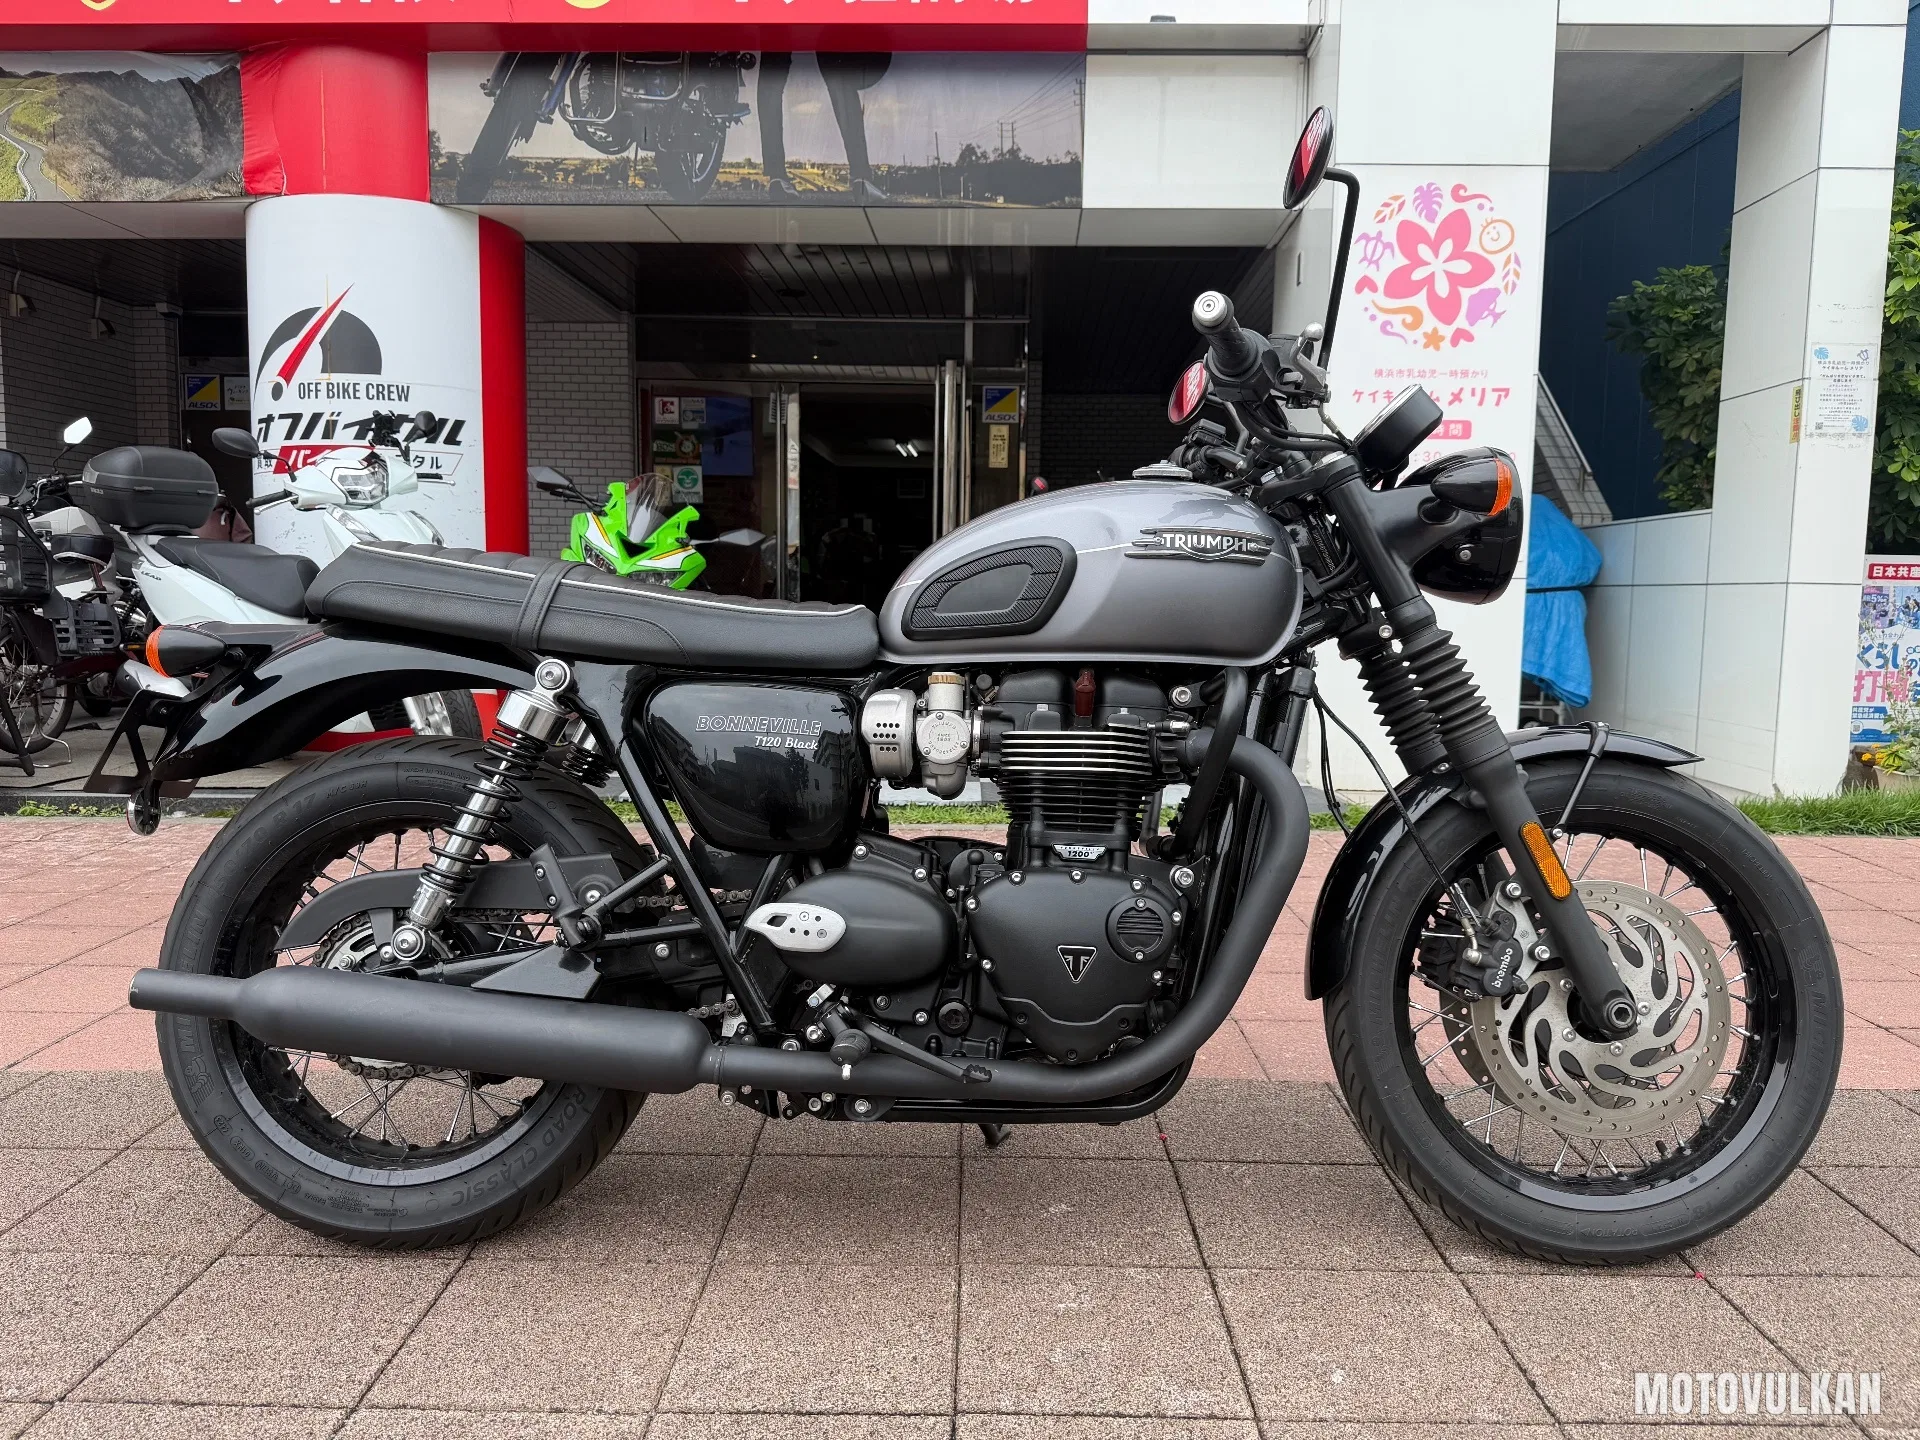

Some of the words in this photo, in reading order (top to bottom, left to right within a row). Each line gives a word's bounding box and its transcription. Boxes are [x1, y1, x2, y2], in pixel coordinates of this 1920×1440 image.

[1374, 368, 1488, 379] 横浜市乳幼児一時預かり
[299, 382, 321, 400] OFF
[326, 382, 361, 401] BIKE
[365, 384, 410, 402] CREW
[188, 401, 218, 409] ALSOK
[985, 413, 1017, 422] ALSOK
[1162, 533, 1247, 553] TRIUMPH
[695, 716, 822, 736] BONNEVILLE
[754, 736, 782, 748] T120
[784, 737, 819, 750] Black
[1067, 850, 1090, 858] 1200
[1491, 947, 1514, 988] brembo
[541, 1085, 588, 1148] ROAD
[451, 1146, 540, 1207] CLASSIC
